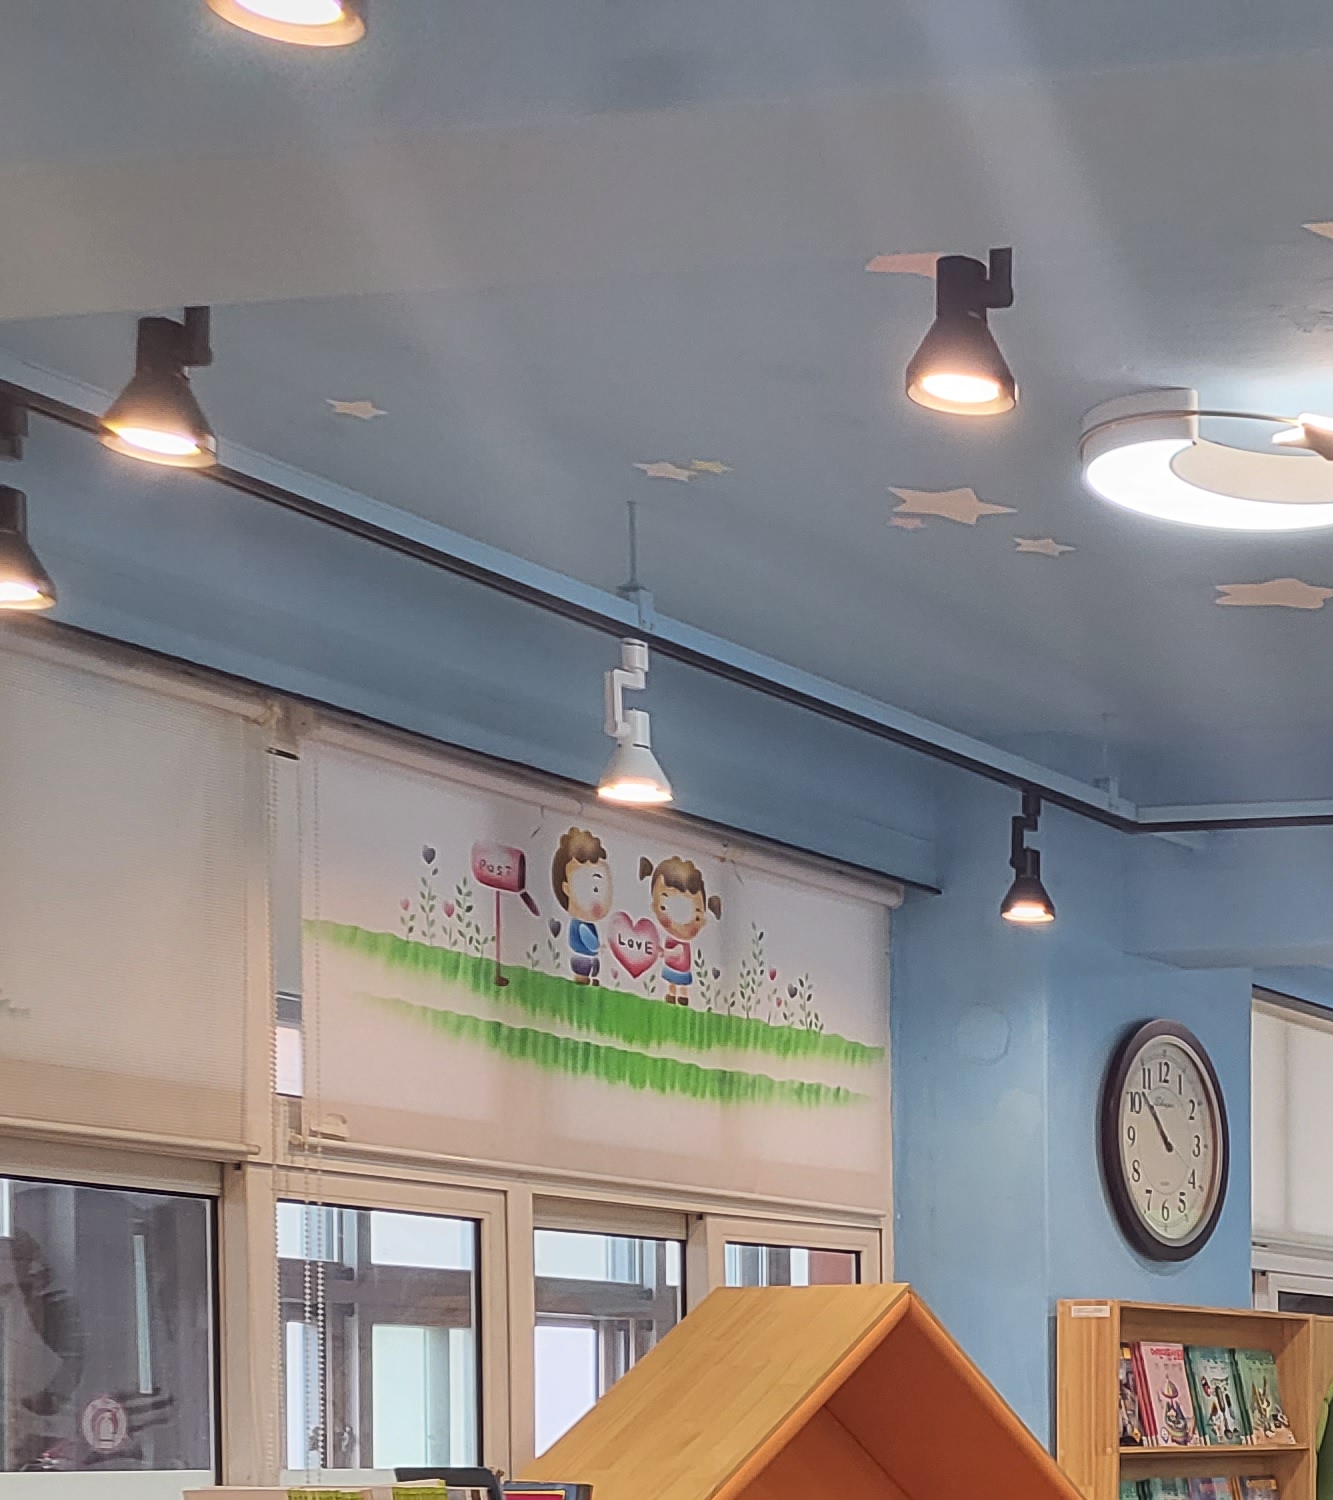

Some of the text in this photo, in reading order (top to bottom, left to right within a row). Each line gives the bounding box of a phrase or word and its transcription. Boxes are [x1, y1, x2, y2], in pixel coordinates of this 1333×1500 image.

[1142, 1067, 1152, 1090] 11
[1158, 1062, 1170, 1084] 12
[1128, 1091, 1142, 1114] 10
[1188, 1099, 1196, 1120] 2
[1127, 1126, 1136, 1147] 9
[1192, 1135, 1201, 1157] 3
[1131, 1160, 1141, 1182] 8
[1187, 1168, 1196, 1189] 4
[1145, 1189, 1153, 1211] 7
[1161, 1199, 1170, 1221] 6
[1178, 1191, 1186, 1213] 5
